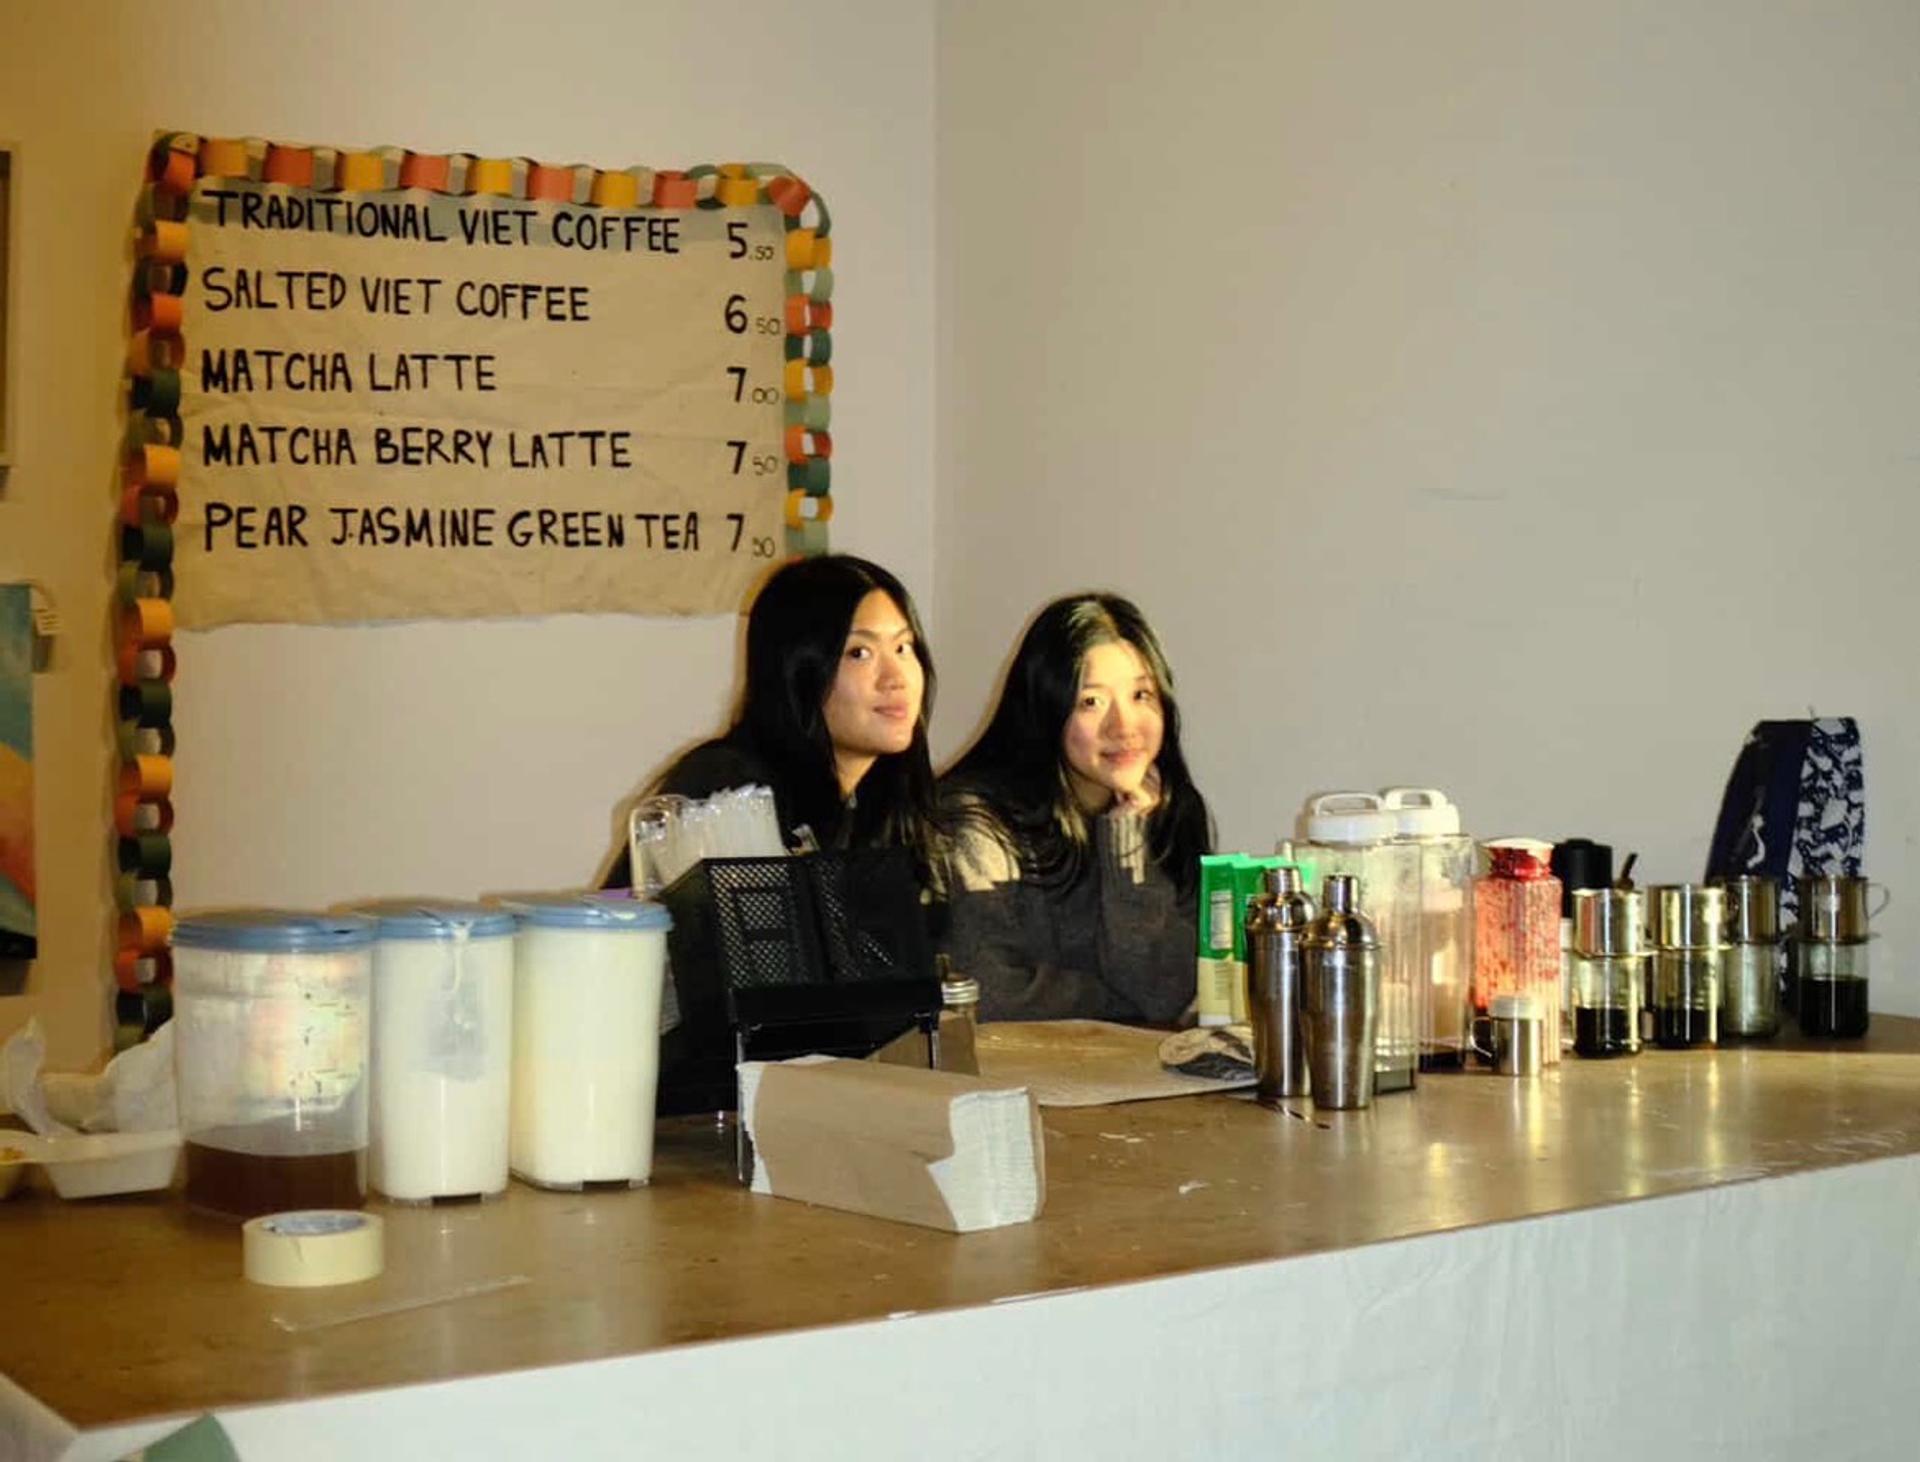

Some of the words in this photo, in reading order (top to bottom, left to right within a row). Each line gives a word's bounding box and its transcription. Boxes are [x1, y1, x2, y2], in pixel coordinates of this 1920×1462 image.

[201, 189, 448, 242] TRADITIONAL
[458, 209, 539, 246] VIET
[552, 211, 681, 254] COFFEE
[202, 266, 347, 312] SALTED
[360, 276, 443, 315] VIET
[456, 281, 590, 321] COFFEE
[201, 349, 353, 393] MATCHA
[368, 353, 497, 392] LATTE
[203, 423, 357, 467] MATCHA
[374, 426, 493, 468] BERRY
[509, 430, 632, 469] LATTE
[204, 502, 309, 552] PEAR
[328, 506, 496, 548] JASMINE
[507, 508, 625, 548] GREEN
[634, 511, 700, 551] TEA
